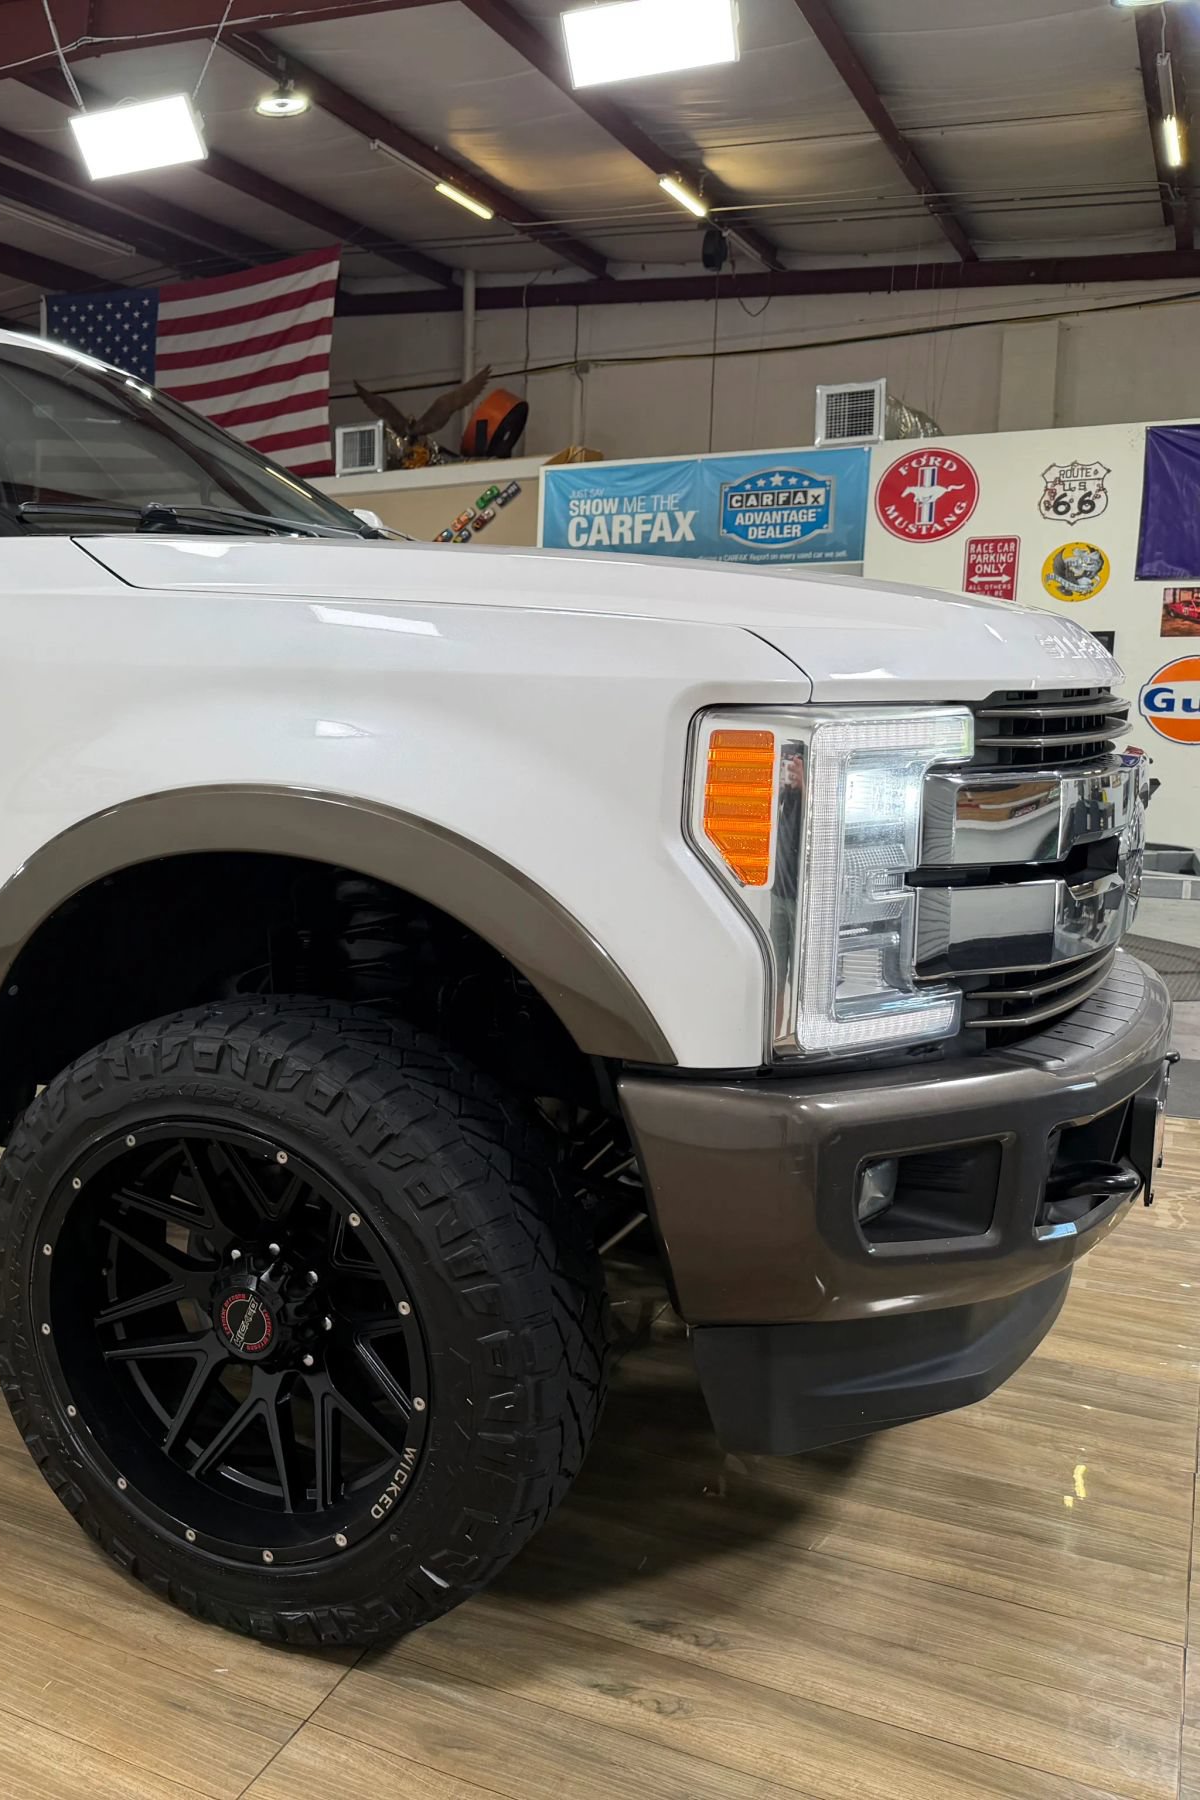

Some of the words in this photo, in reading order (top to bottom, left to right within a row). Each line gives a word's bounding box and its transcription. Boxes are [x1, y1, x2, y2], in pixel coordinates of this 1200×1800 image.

[898, 456, 958, 476] FORD
[1059, 467, 1092, 479] ROUTE
[568, 497, 619, 516] SHOW
[622, 495, 646, 513] ME
[650, 493, 680, 512] THE
[730, 490, 821, 508] CARFAX
[1052, 491, 1096, 515] 66
[734, 508, 817, 526] ADVANTAGE
[884, 501, 967, 535] MUSTANG
[567, 510, 696, 548] CARFAX
[747, 524, 802, 540] DEALER
[969, 543, 994, 554] RACE
[996, 542, 1016, 553] CAR
[969, 553, 1014, 564] PARKING
[975, 563, 1007, 574] ONLY
[370, 1447, 417, 1519] WICKED
